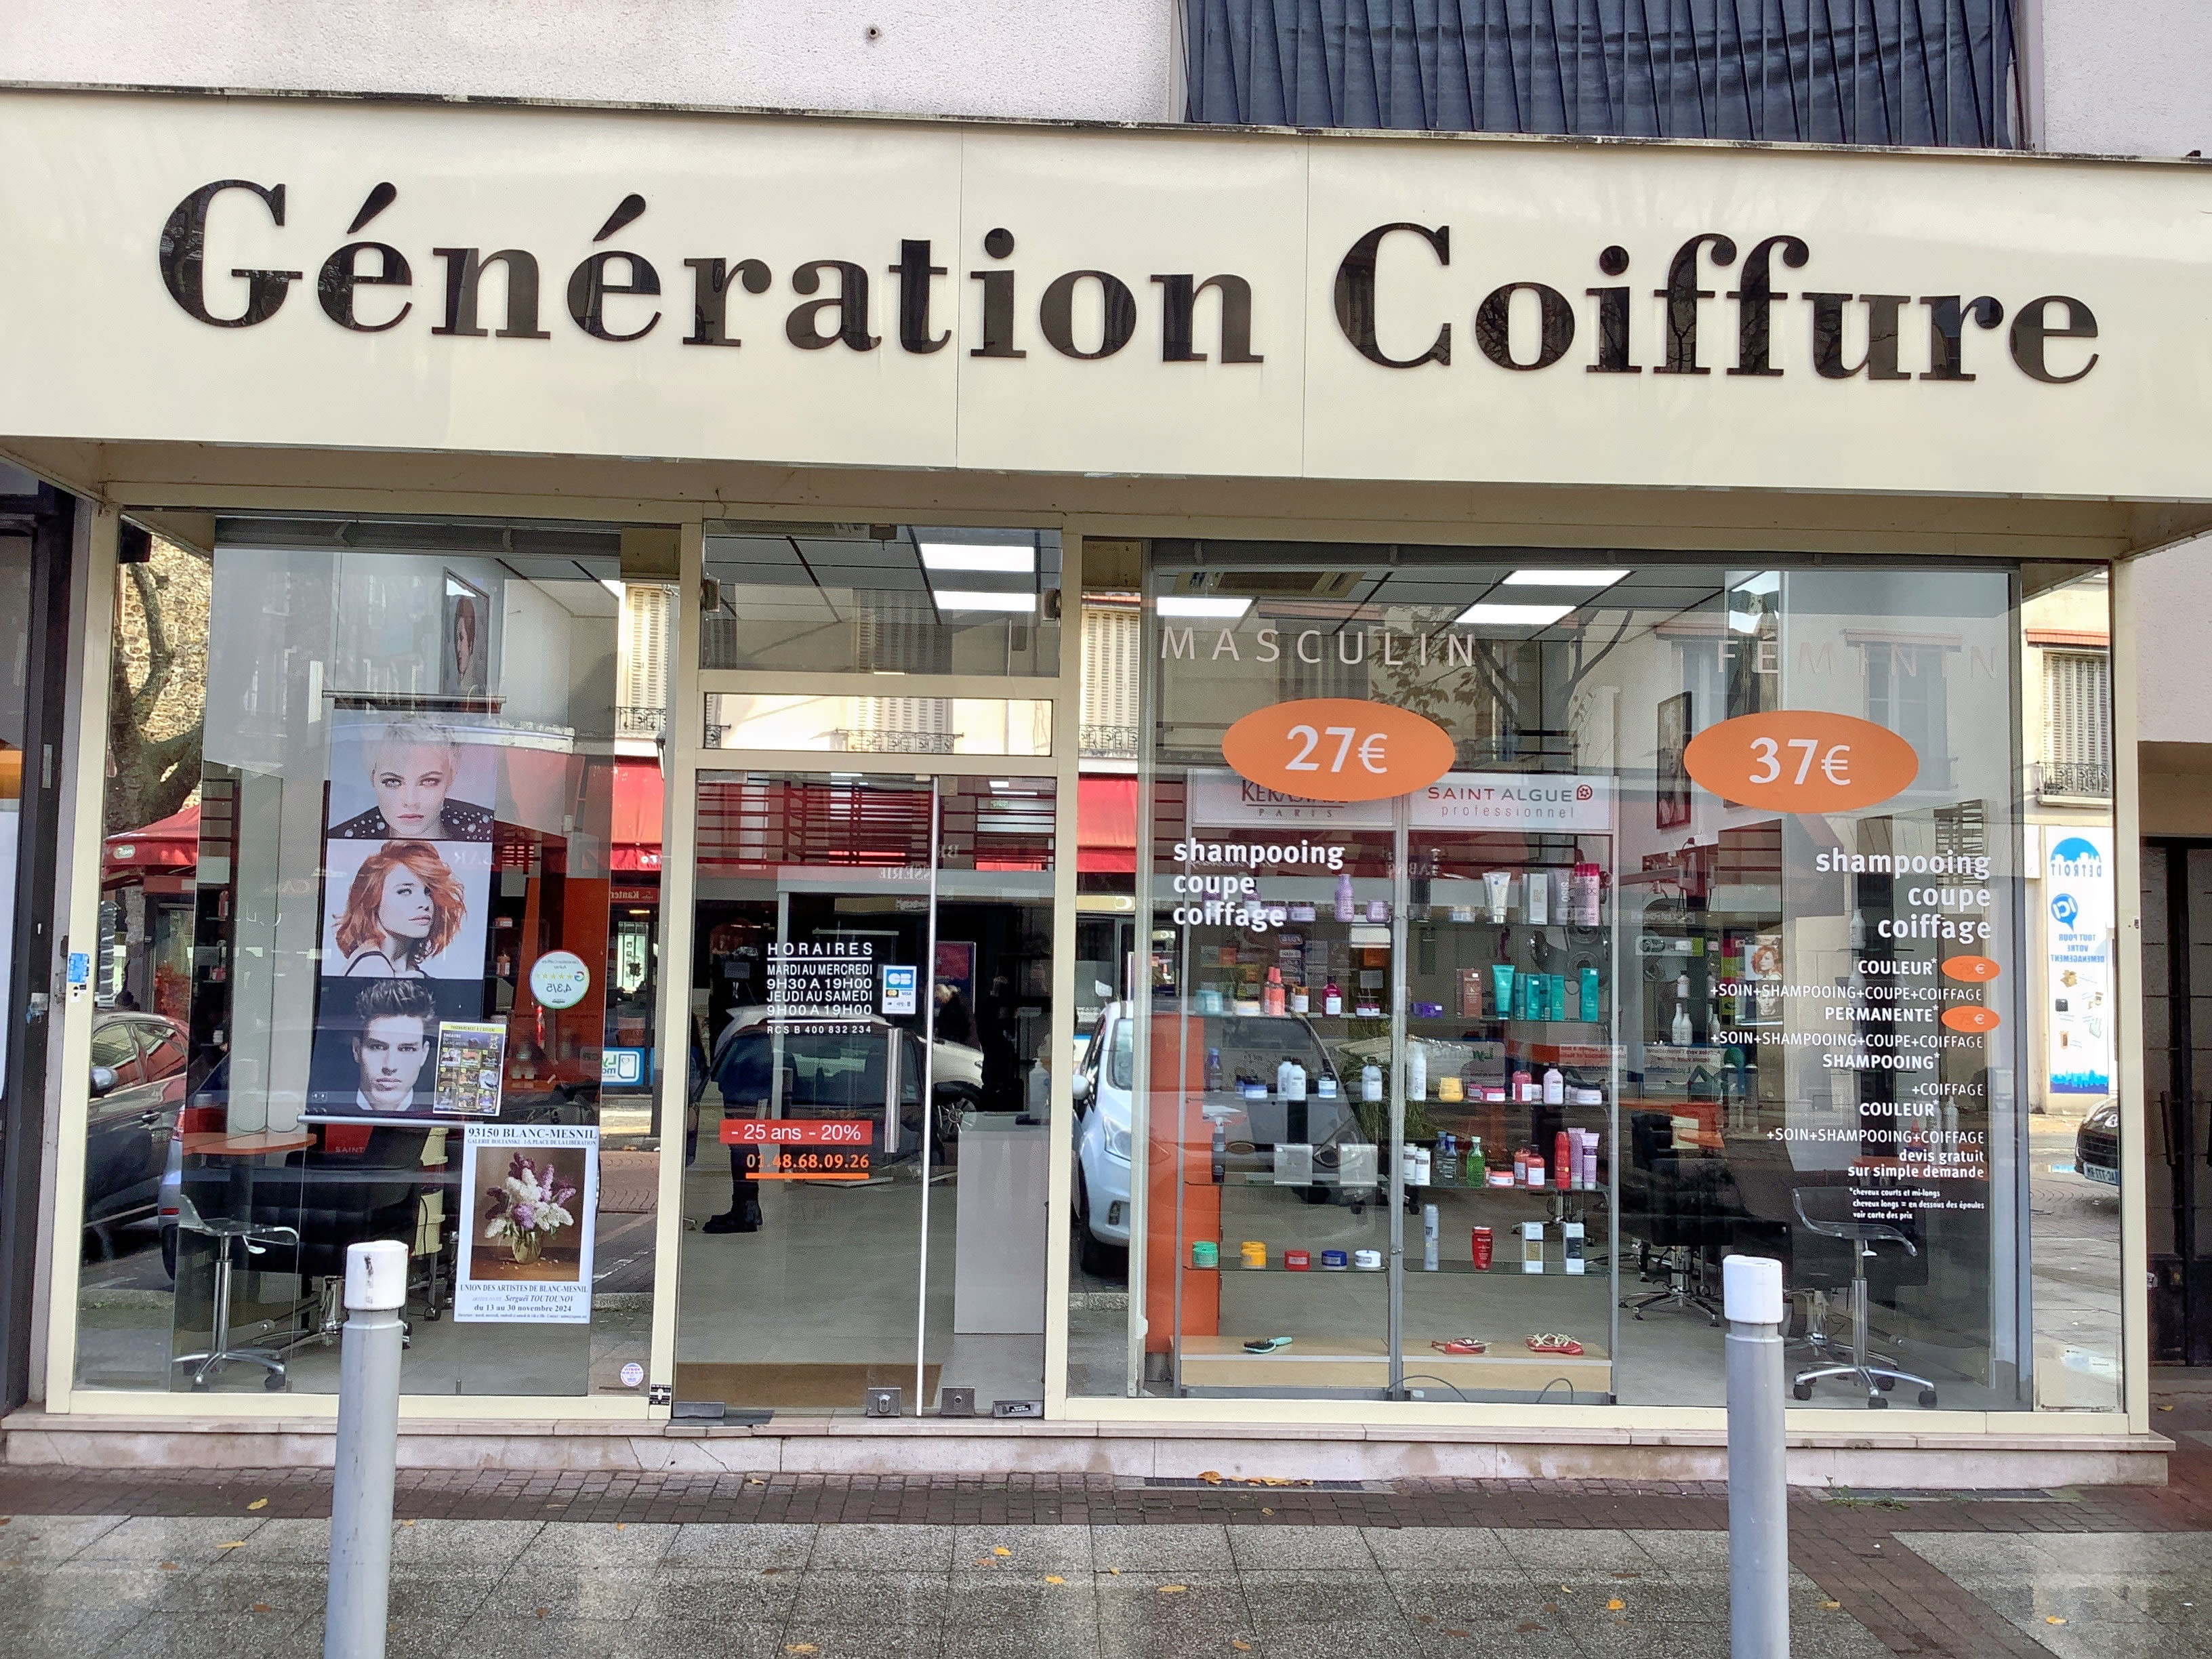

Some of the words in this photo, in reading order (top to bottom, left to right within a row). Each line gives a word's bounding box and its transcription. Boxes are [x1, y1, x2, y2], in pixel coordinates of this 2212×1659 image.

[159, 179, 1264, 364] Génération
[1334, 222, 2100, 384] Coiffure
[1161, 626, 1476, 668] MASCULIN
[1284, 725, 1388, 775] 27€
[1749, 737, 1851, 786] 37€
[1428, 786, 1494, 800] SAINT
[1501, 788, 1572, 802] ALGUE
[1258, 808, 1333, 818] PARIS
[1441, 805, 1574, 819] professionnel
[1173, 838, 1345, 870] shampooing
[1816, 847, 1992, 880] shampooing
[1173, 874, 1255, 902] coupe
[1908, 885, 1992, 914] coupe
[1173, 902, 1287, 934] coiffage
[1878, 914, 1992, 945] coiffage
[767, 942, 873, 956] HORAIRES
[767, 964, 801, 975] MARDI
[802, 964, 817, 975] AU
[818, 964, 873, 975] MERCREDI
[766, 978, 806, 989] 9H30
[810, 978, 820, 989] A
[825, 978, 872, 989] 19H00
[766, 991, 804, 1002] JEUDI
[806, 991, 822, 1002] AU
[825, 990, 872, 1002] SAMEDI
[1710, 983, 1983, 1002] +SOIN+SHAMPOOING+COUPE+COIFFAGE
[766, 1004, 806, 1016] 9H00
[810, 1004, 819, 1015] A
[824, 1004, 872, 1015] 19H00
[767, 1025, 790, 1034] RCS
[794, 1025, 800, 1034] B
[805, 1025, 824, 1034] 400
[828, 1025, 848, 1034] 832
[852, 1025, 872, 1034] 234
[1711, 1031, 1984, 1049] +SOIN+SHAMPOOING+COUPE+COIFFAGE
[1912, 1084, 1984, 1097] +COIFFAGE
[468, 1127, 499, 1138] 93150
[503, 1128, 597, 1139] BLANC-MESNIL
[744, 1124, 766, 1140] 25
[771, 1126, 802, 1141] ans
[821, 1124, 862, 1141] 20%
[1766, 1128, 1984, 1145] +SOIN+SHAMPOOING+COIFFAGE
[746, 1153, 870, 1169] 01.48.68.09.26
[1900, 1149, 1935, 1163] devis
[1939, 1149, 1985, 1165] gratuit
[1847, 1166, 1869, 1176] sur
[1873, 1164, 1919, 1181] simple
[1923, 1165, 1985, 1178] demande
[1881, 1189, 1902, 1197] courts
[1912, 1188, 1941, 1199] mi-longs
[1852, 1199, 1880, 1208] cheveux
[1881, 1199, 1899, 1210] longs
[1919, 1200, 1945, 1209] dessous
[1946, 1201, 1958, 1209] des
[1886, 1211, 1898, 1219] des
[1899, 1210, 1914, 1221] prix
[539, 1285, 588, 1293] BLANC-MESNIL
